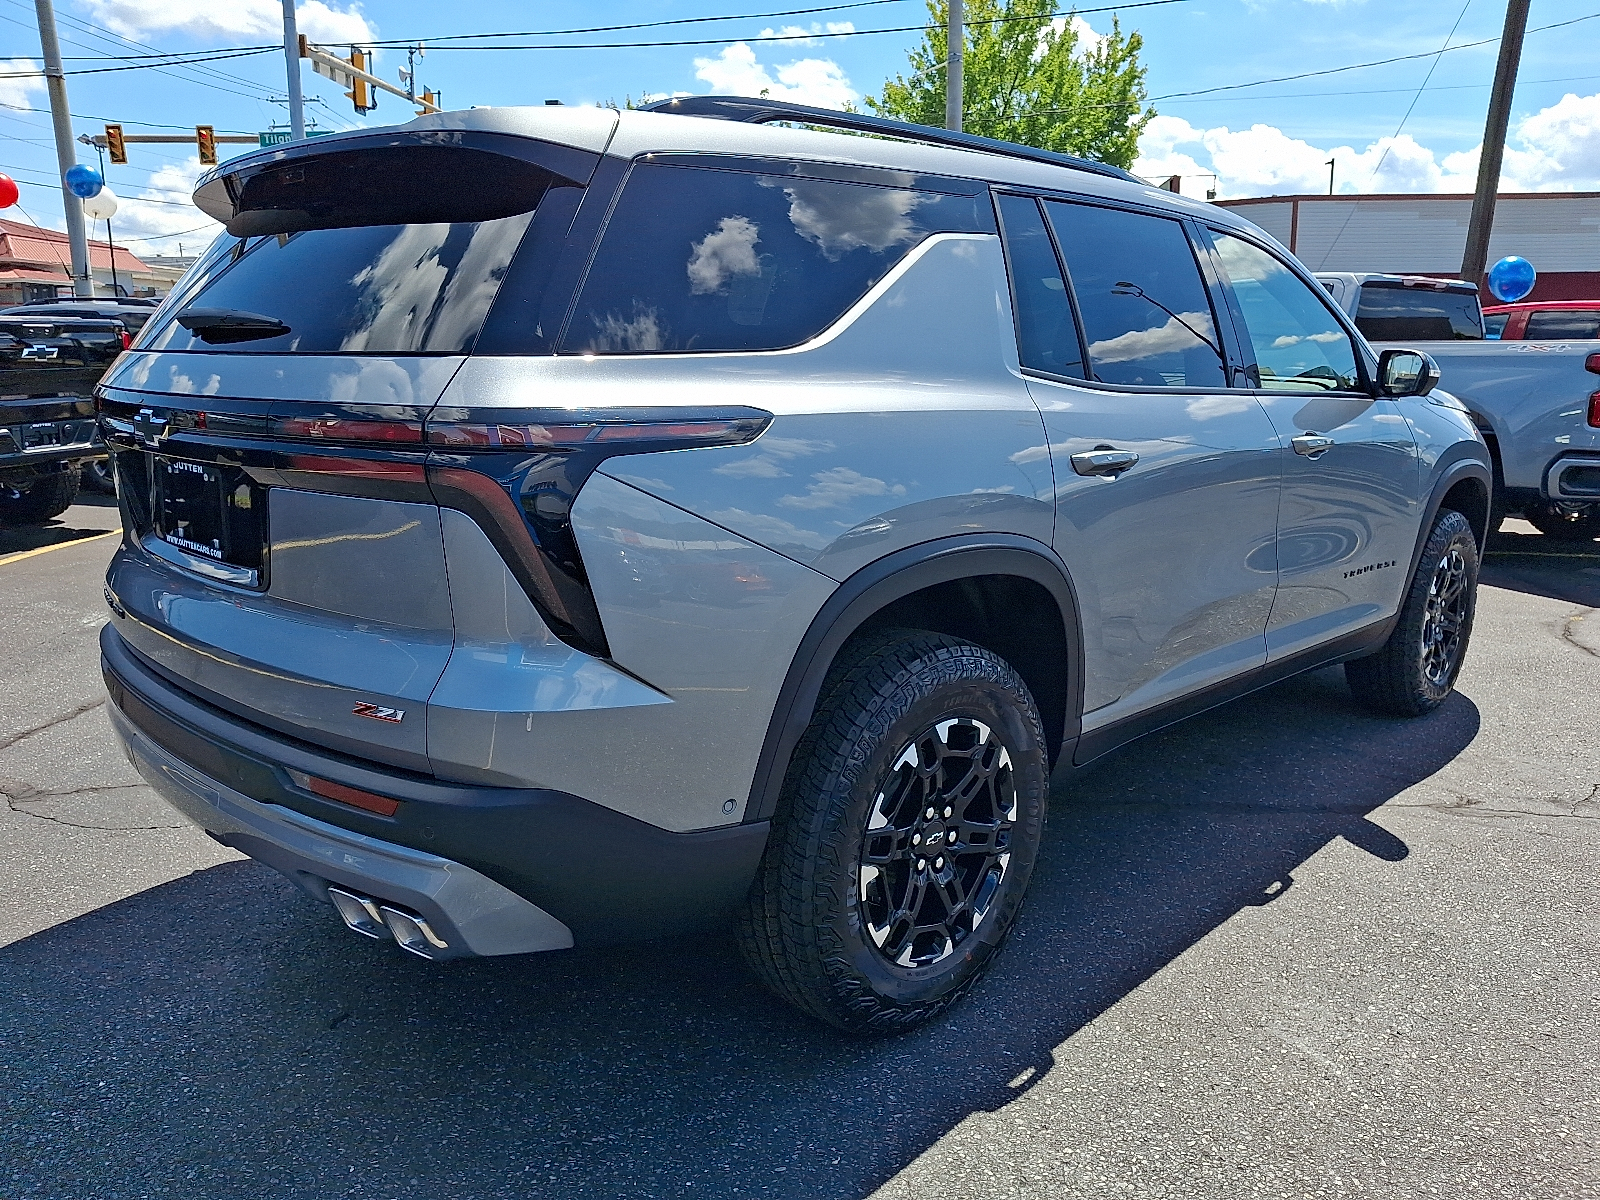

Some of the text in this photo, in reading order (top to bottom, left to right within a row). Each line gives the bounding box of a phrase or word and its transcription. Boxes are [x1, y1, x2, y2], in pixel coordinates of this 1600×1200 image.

[264, 133, 292, 145] Tilgh
[1343, 560, 1396, 579] TRAVERSE
[352, 700, 406, 724] Z71
